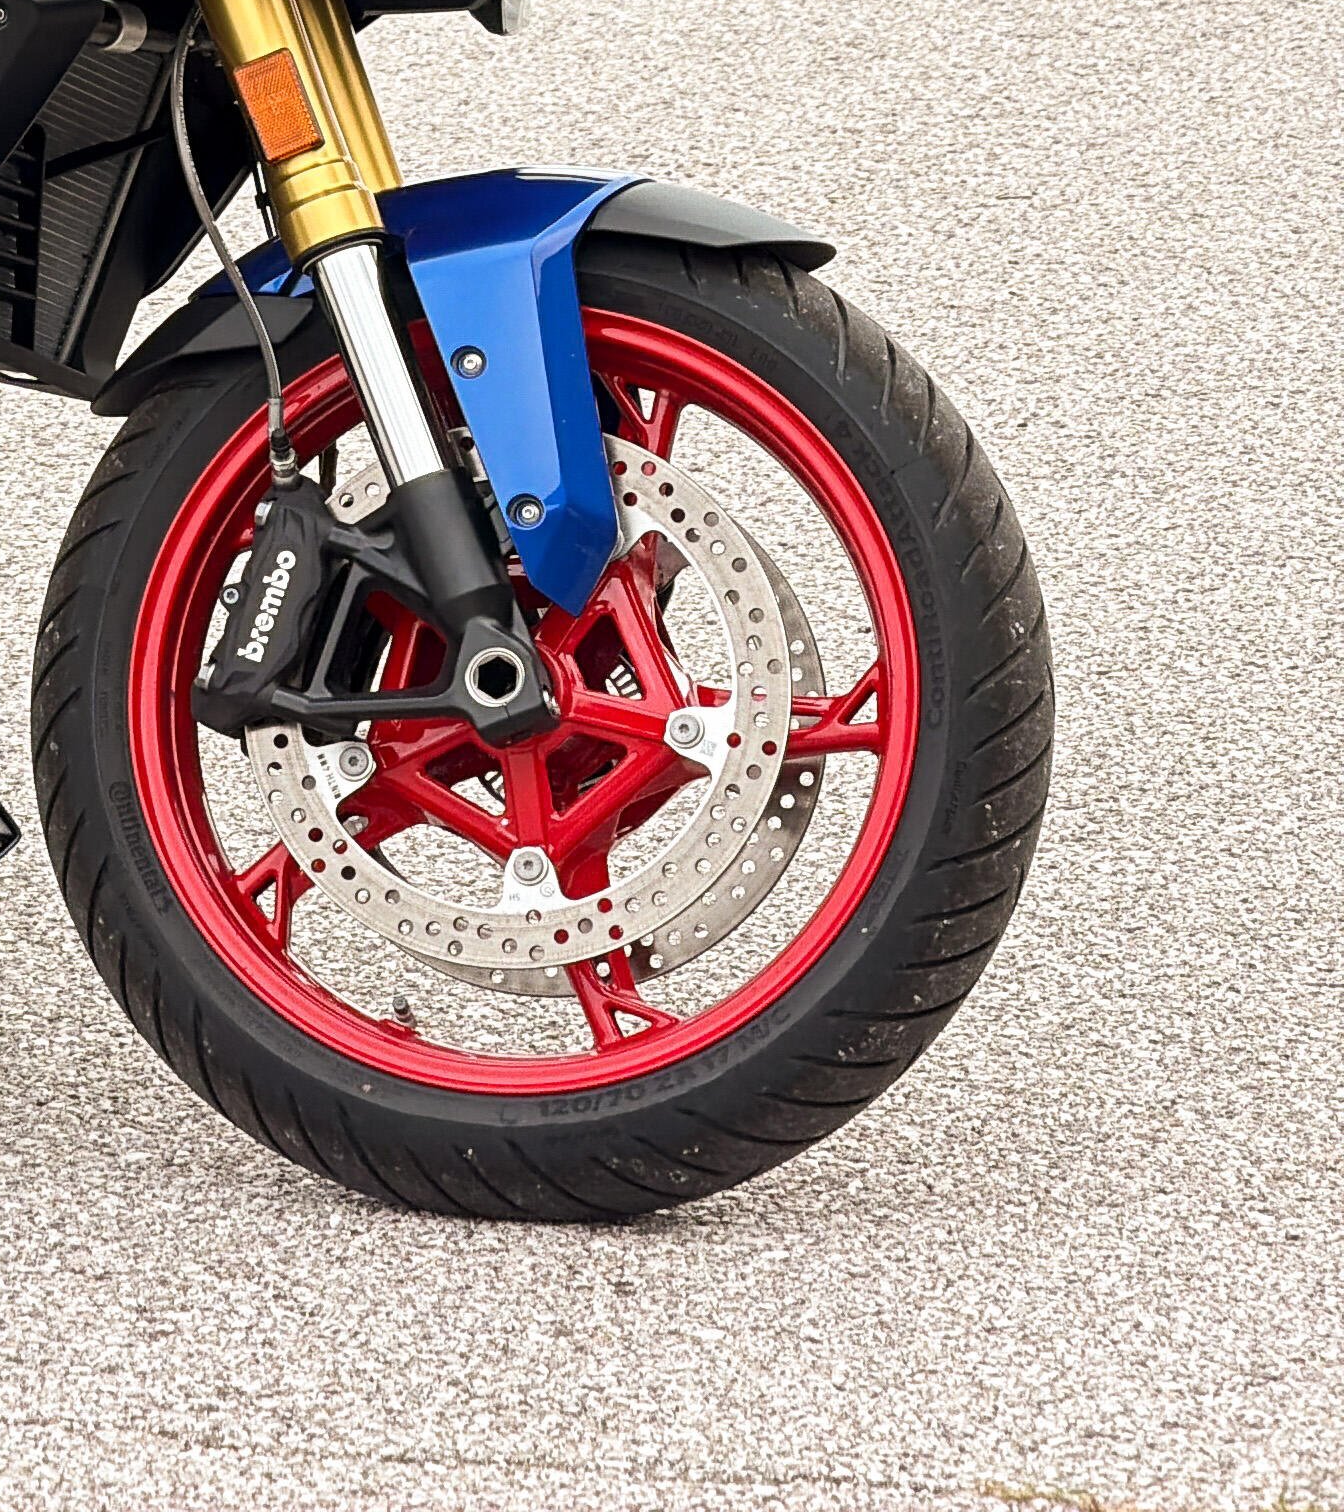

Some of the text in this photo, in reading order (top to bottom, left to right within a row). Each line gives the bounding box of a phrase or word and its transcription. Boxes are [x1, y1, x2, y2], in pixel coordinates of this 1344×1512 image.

[237, 549, 297, 664] brembo
[108, 780, 175, 915] Continental
[538, 1083, 648, 1118] 120/70
